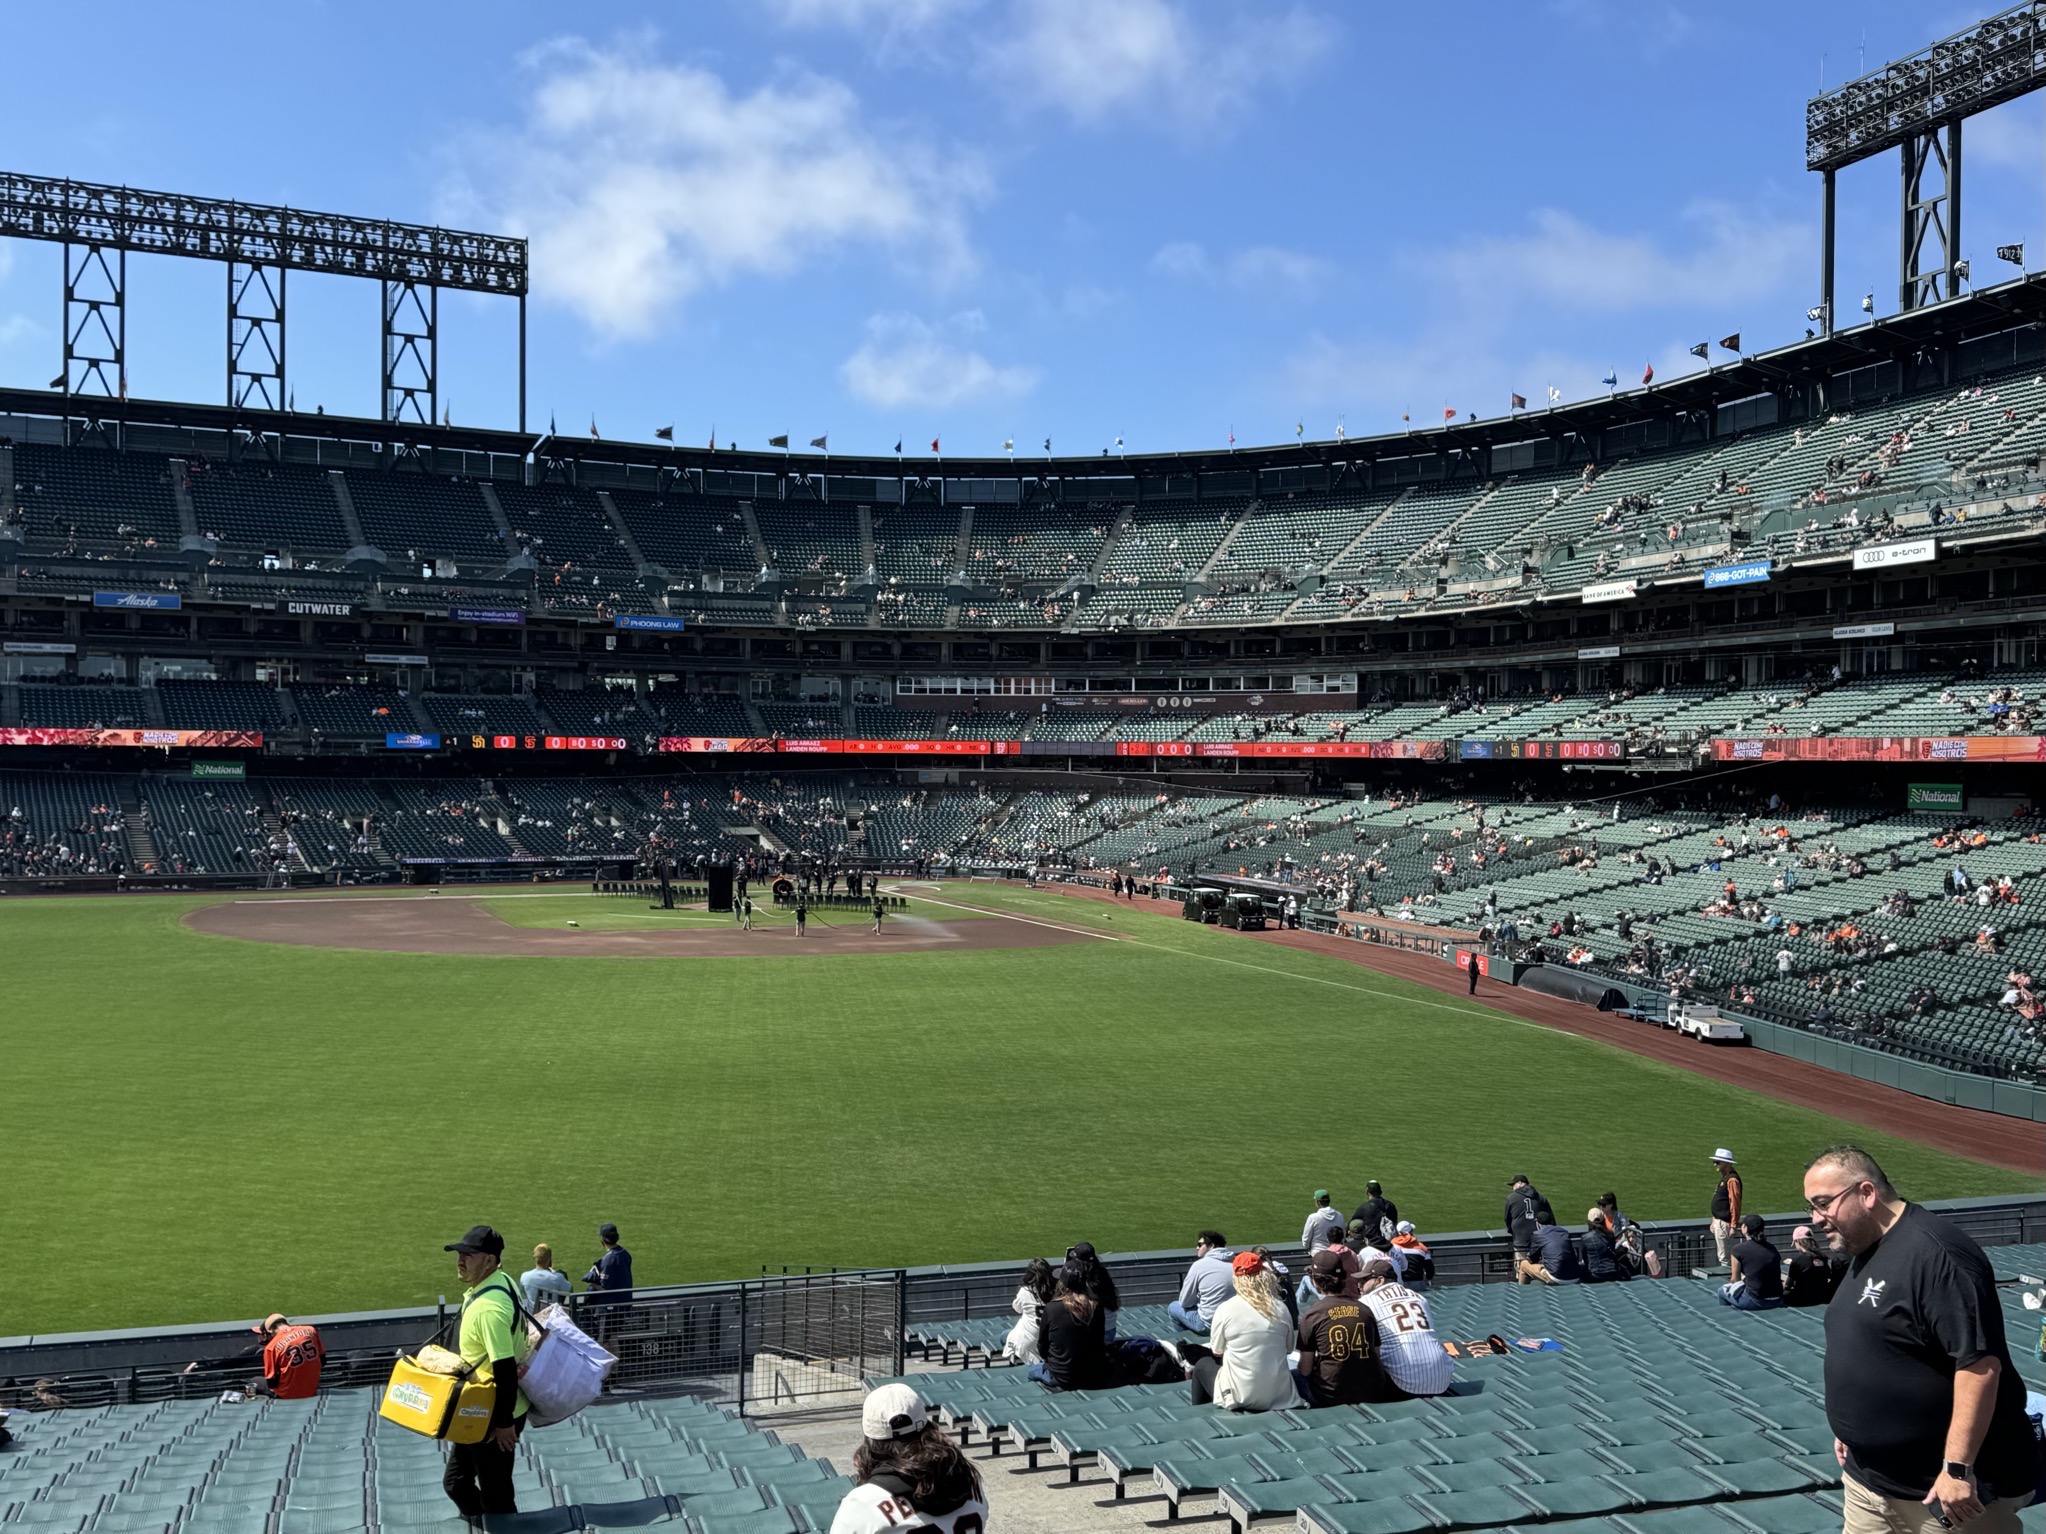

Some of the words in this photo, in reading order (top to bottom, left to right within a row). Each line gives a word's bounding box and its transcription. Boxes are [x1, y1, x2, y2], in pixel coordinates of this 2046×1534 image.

[1892, 548, 1926, 557] e-tron
[117, 594, 158, 608] Alaska
[288, 602, 350, 616] CUTWATER
[453, 737, 457, 745] 1
[501, 736, 509, 748] 0
[552, 737, 560, 748] 0
[1529, 744, 1535, 756] 0
[1564, 744, 1570, 756] 0
[1932, 749, 1967, 757] NOSOTROS
[205, 766, 243, 774] National
[1921, 790, 1960, 802] National
[1524, 1198, 1534, 1219] 1
[1376, 1285, 1408, 1301] TATIS
[1391, 1303, 1430, 1332] 23
[1329, 1322, 1369, 1361] 84
[286, 1339, 318, 1368] 35
[642, 1342, 660, 1355] 138
